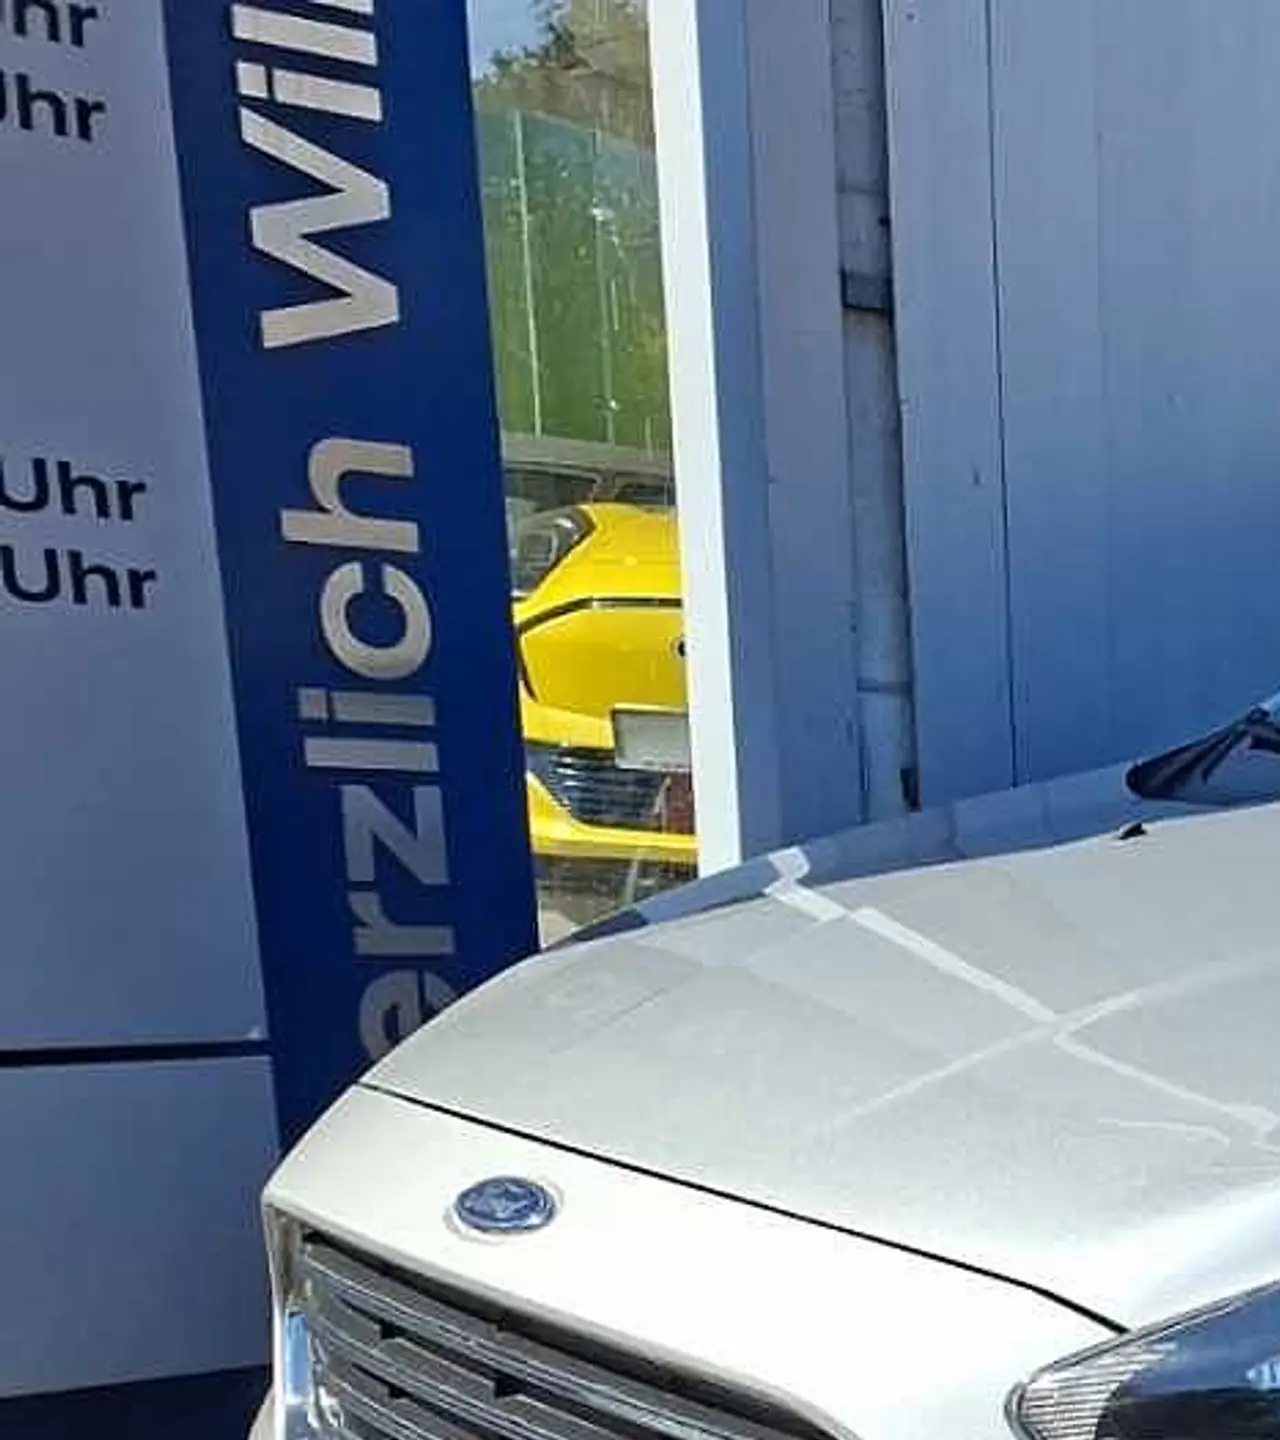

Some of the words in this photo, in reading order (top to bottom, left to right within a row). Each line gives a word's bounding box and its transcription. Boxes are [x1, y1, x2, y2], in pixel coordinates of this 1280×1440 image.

[231, 0, 399, 349] Wil
[0, 456, 147, 521] Uhr
[0, 545, 157, 609] Uhr
